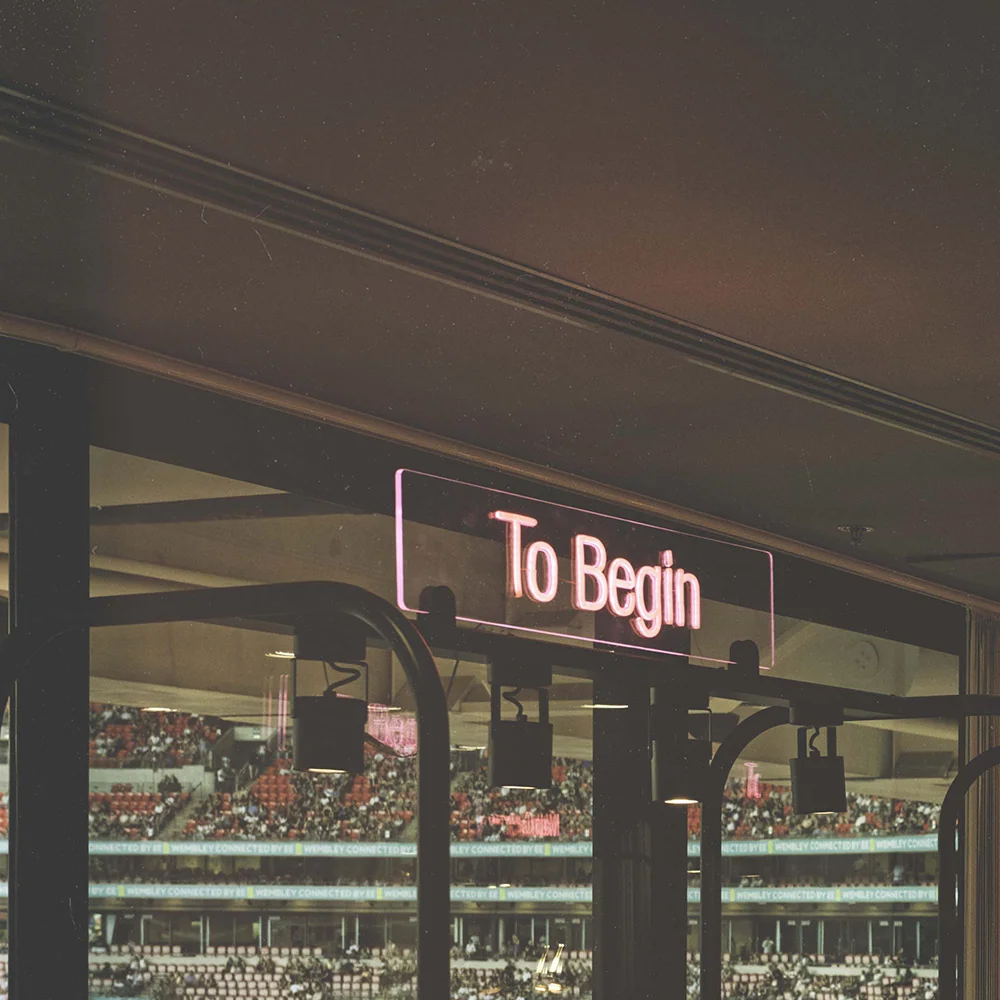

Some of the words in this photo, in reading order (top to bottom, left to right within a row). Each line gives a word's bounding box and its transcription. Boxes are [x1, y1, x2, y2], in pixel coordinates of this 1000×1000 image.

[488, 510, 559, 603] To
[571, 534, 701, 638] Begin
[775, 841, 808, 852] WEMBLEY
[809, 840, 851, 851] CONNECTED
[876, 839, 906, 849] WEMBLEY
[906, 838, 938, 849] CONNECT
[89, 844, 140, 854] ONNECTED
[170, 844, 214, 854] WEMBLEY
[215, 844, 271, 854] CONNECTED
[304, 844, 346, 854] WEMBLEY
[346, 845, 400, 855] CONNECTED
[471, 844, 522, 855] CONNECTED
[552, 845, 590, 854] WEMBLEY
[126, 887, 166, 897] WEMBLEY
[167, 888, 222, 898] CONNECTED
[256, 889, 298, 899] WEMBLEY
[298, 889, 352, 899] CONNECTED
[507, 890, 547, 900] WEMBLEY
[547, 890, 592, 900] CONNECTE
[736, 891, 772, 900] WEMBLEY
[773, 891, 816, 900] CONNECTED
[842, 890, 874, 900] WEMBLEY
[875, 890, 917, 900] CONNECTED
